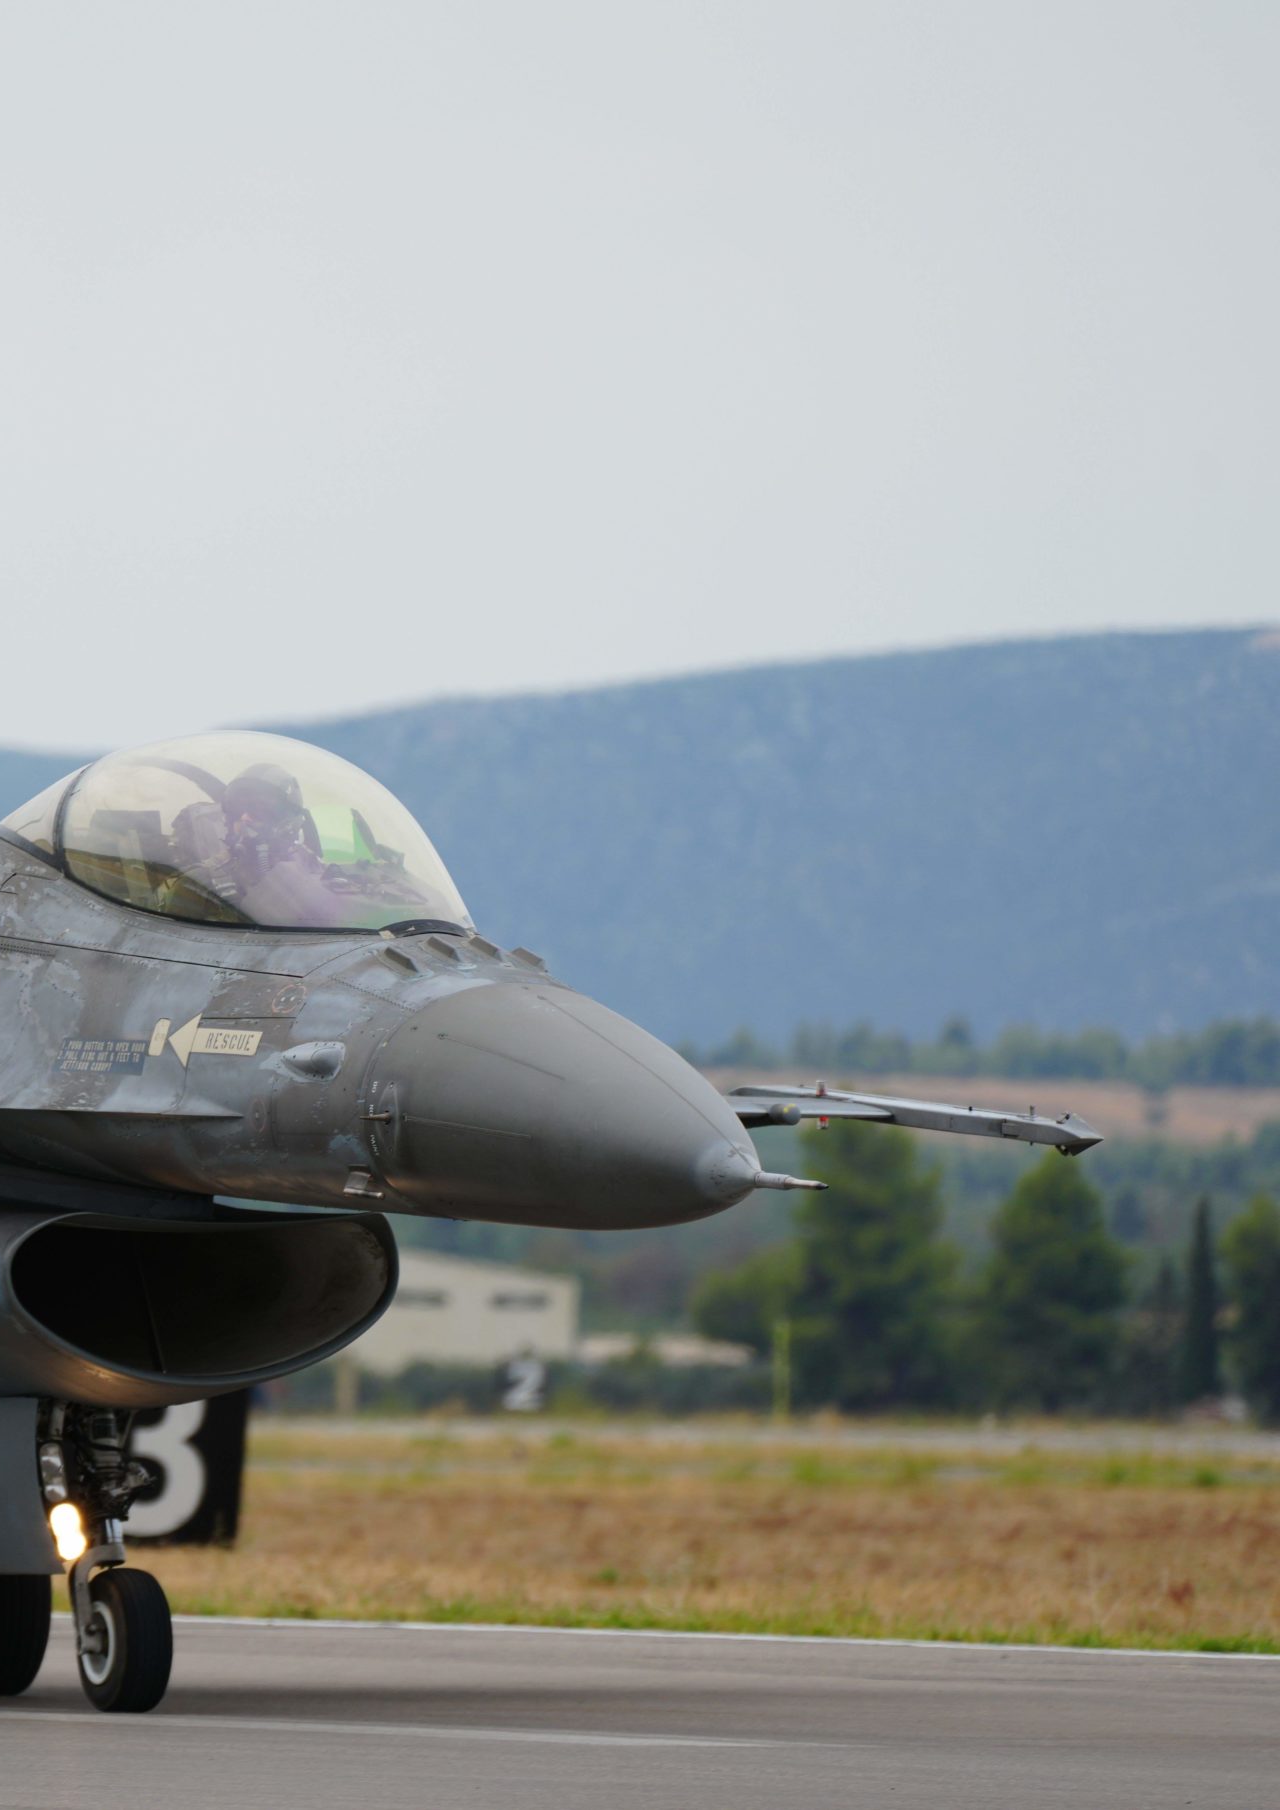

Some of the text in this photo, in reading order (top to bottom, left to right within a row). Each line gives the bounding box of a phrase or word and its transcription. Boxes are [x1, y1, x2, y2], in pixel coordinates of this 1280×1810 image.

[205, 1032, 254, 1051] RESCUE
[502, 1360, 544, 1410] 2
[122, 1399, 207, 1535] 3
